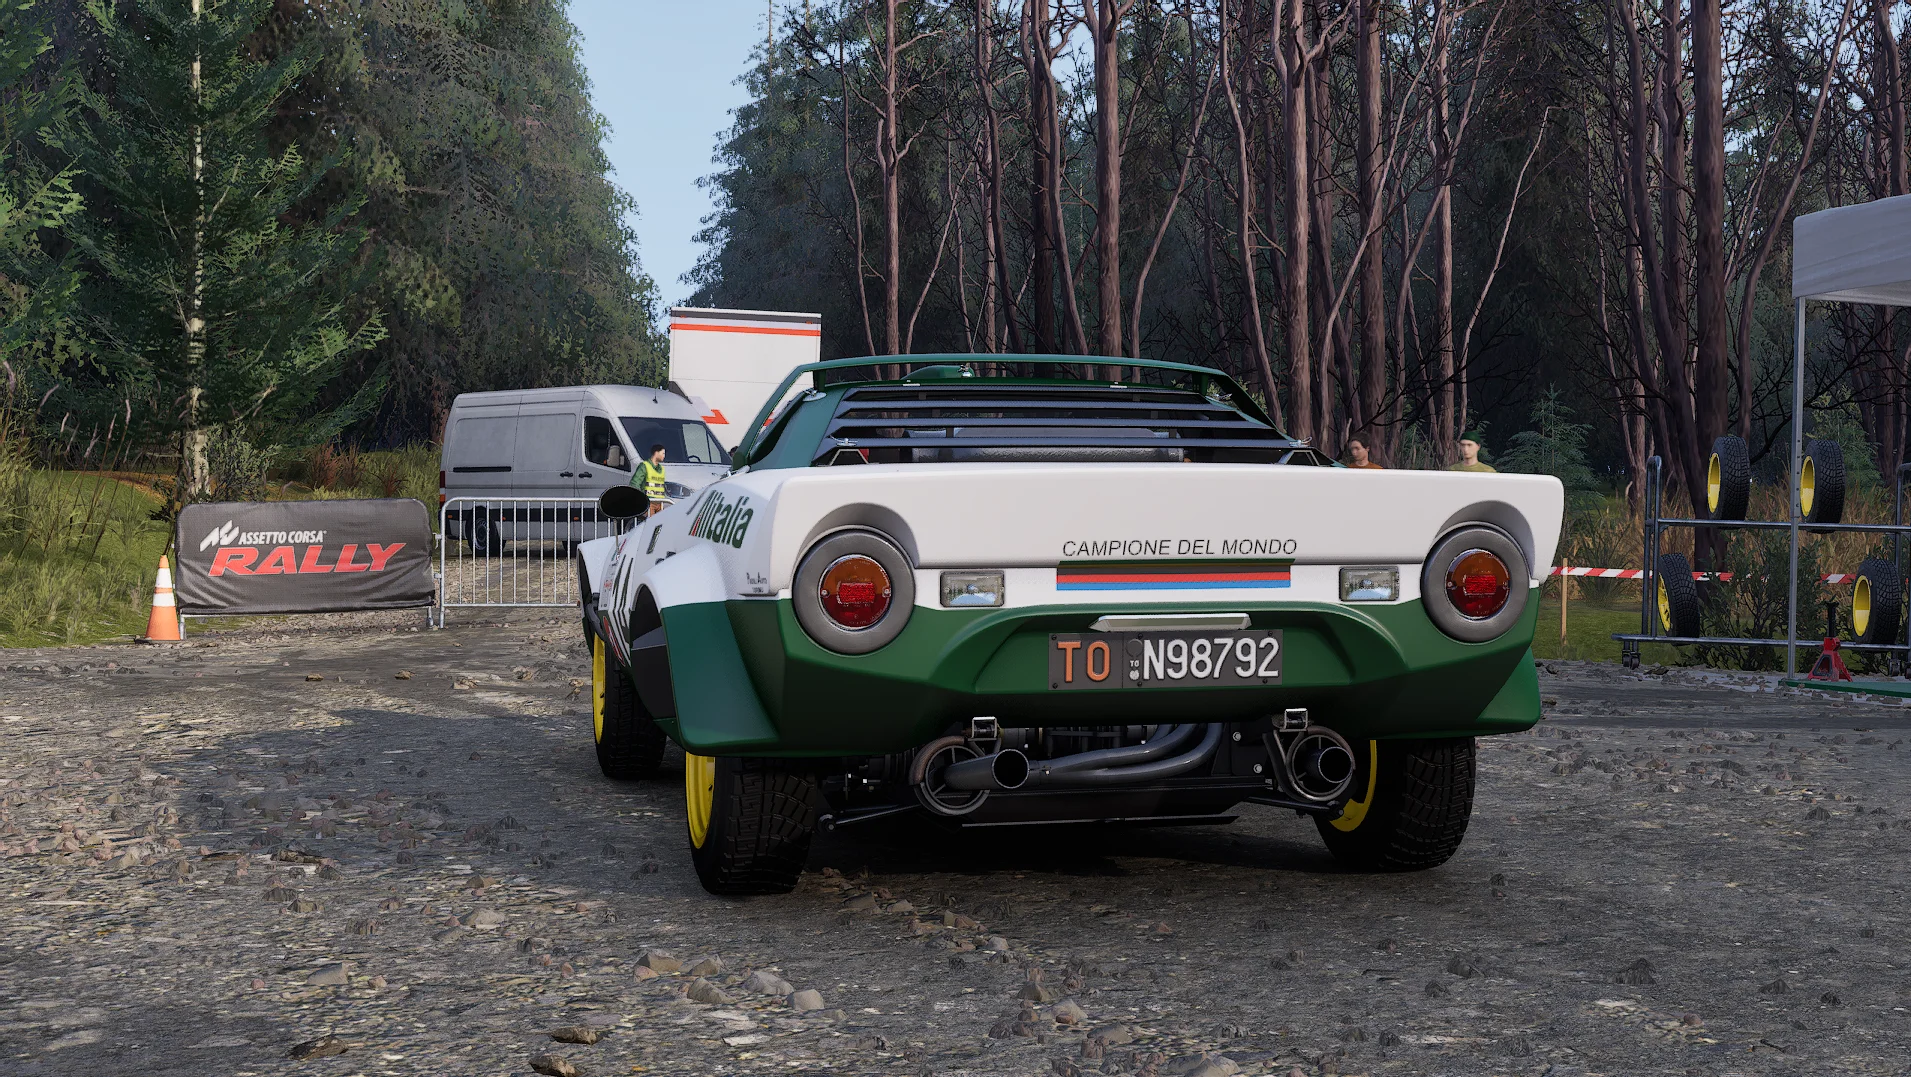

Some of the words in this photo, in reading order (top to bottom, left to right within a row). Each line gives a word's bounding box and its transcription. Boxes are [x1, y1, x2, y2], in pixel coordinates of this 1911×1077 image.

[688, 490, 753, 549] Alitalia
[238, 531, 287, 545] ASSETTO
[288, 530, 324, 544] CORSA
[1062, 539, 1171, 557] CAMPIONE
[1178, 539, 1214, 555] DEL
[1222, 538, 1298, 555] MONDO
[208, 543, 406, 577] RALLY
[1057, 640, 1110, 682] TO
[1143, 637, 1280, 680] N98792
